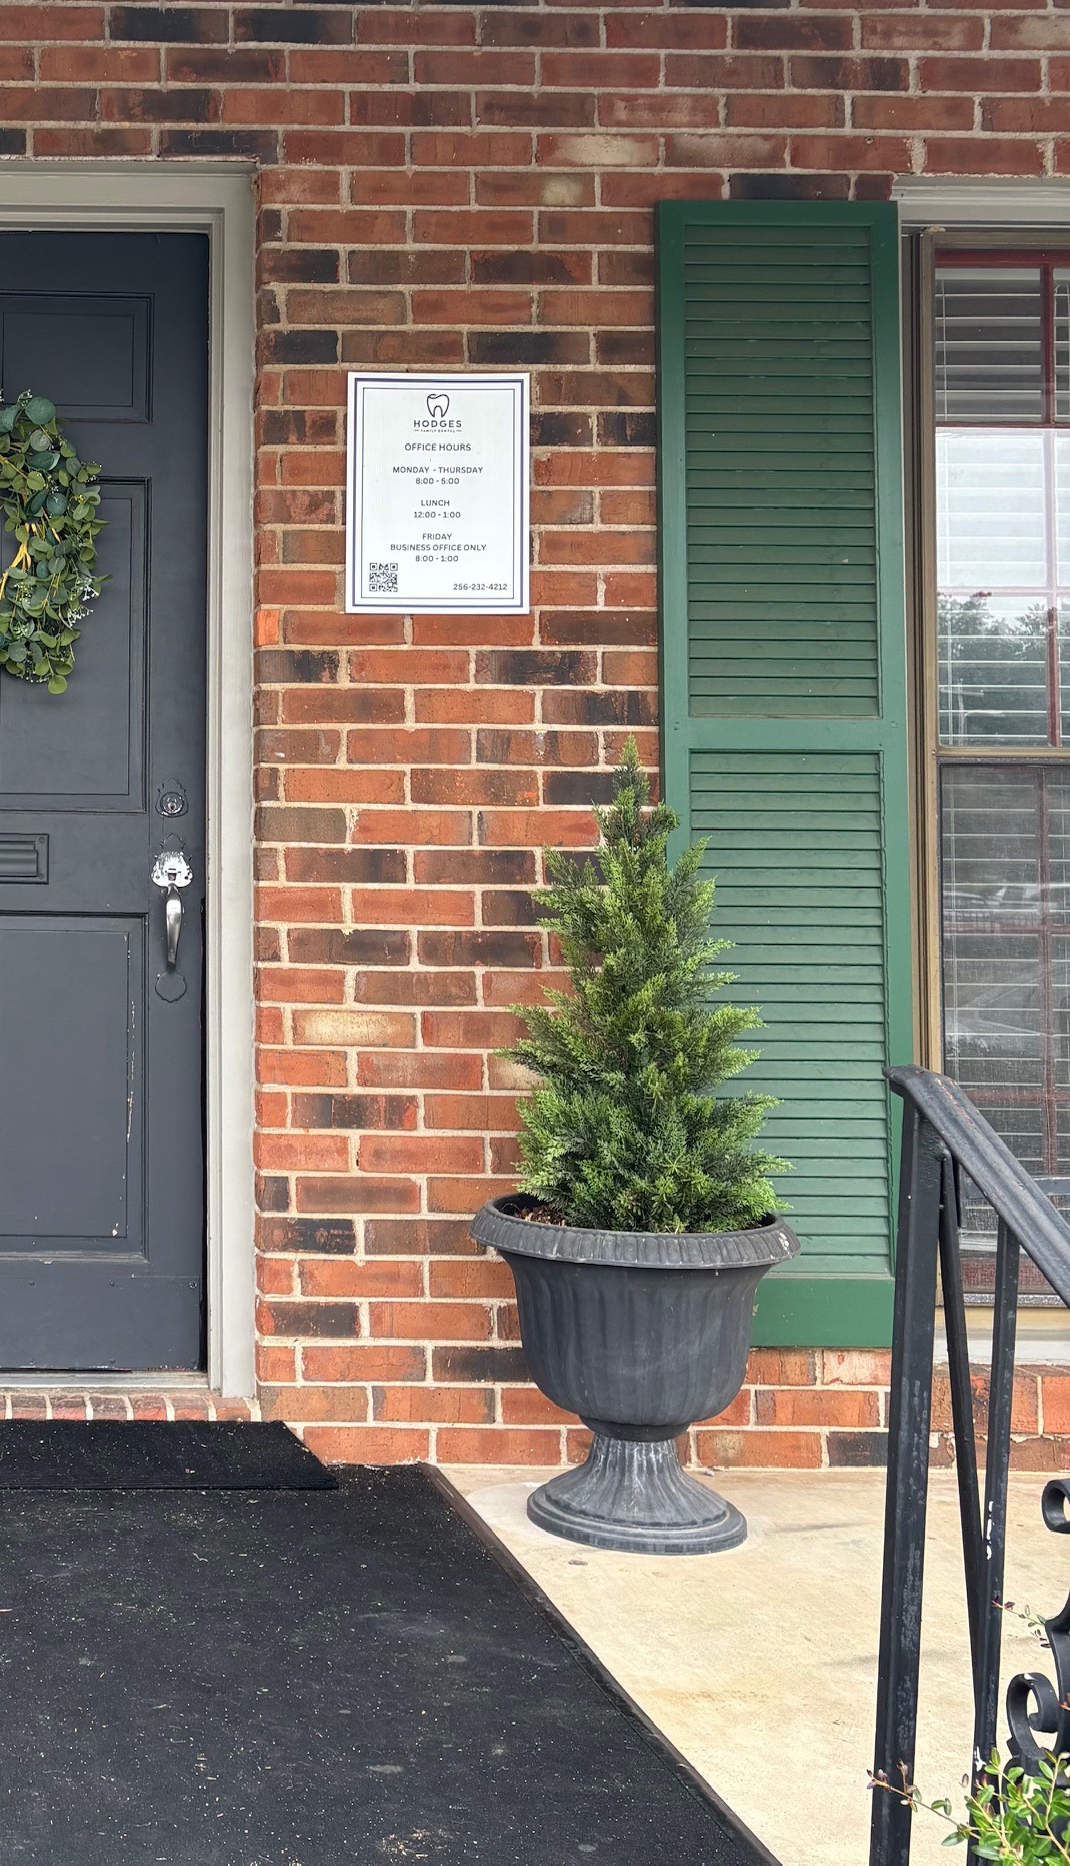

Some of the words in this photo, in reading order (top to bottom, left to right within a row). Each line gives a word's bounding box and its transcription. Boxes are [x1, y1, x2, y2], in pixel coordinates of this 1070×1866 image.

[413, 419, 462, 428] HODGES
[404, 442, 437, 452] OFFICE
[438, 442, 472, 452] HOURS
[392, 466, 430, 474] MONDAY
[437, 466, 484, 474] THURSDAY
[415, 477, 435, 485] 8:00
[440, 477, 460, 485] 5:00
[420, 499, 450, 507] LUNCH
[414, 511, 437, 519] 12:00
[442, 511, 462, 519] 1:00
[422, 532, 453, 541] FRIDAY
[390, 543, 432, 552] BUSINESS
[432, 543, 462, 552] OFFICE
[463, 543, 487, 552] ONLY
[415, 554, 434, 563] 8:00
[440, 554, 459, 563] 1:00
[453, 583, 508, 591] 256-232-4212
